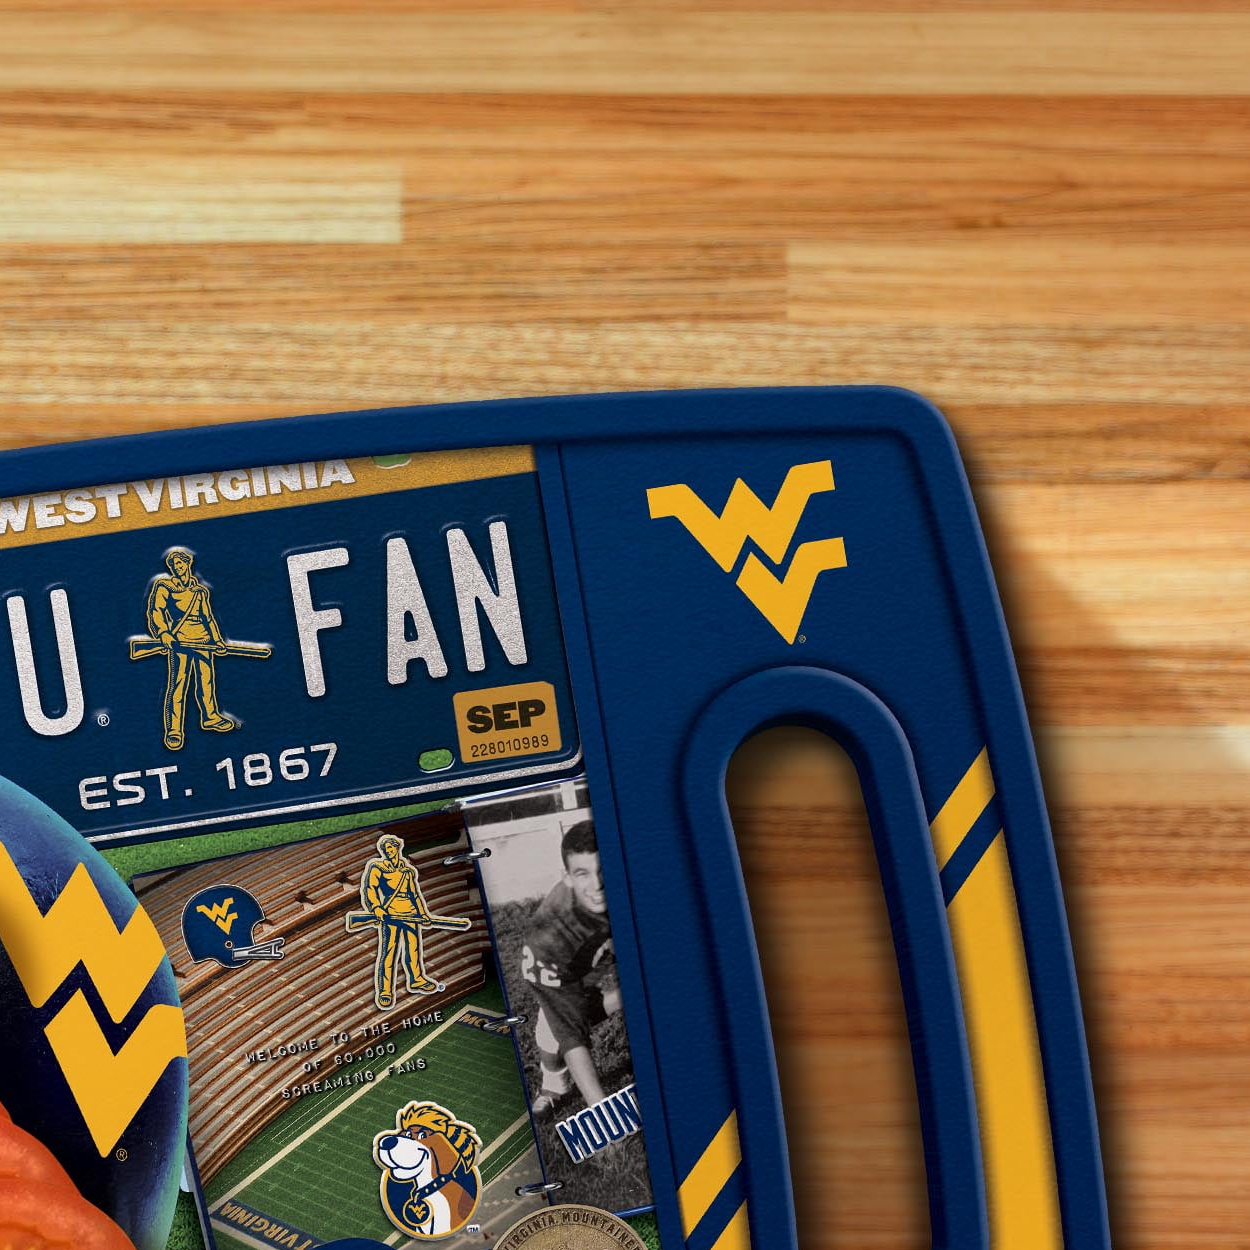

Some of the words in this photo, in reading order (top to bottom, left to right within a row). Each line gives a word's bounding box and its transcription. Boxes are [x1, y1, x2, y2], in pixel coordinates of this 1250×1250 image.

[132, 459, 356, 513] VIRGINIA
[287, 521, 527, 698] FAN
[467, 699, 546, 734] SEP
[471, 734, 549, 758] 228010989
[78, 765, 193, 811] EST.
[216, 742, 338, 790] 1867
[246, 1039, 319, 1063] WELCOME
[330, 1032, 349, 1045] TO
[361, 1022, 391, 1037] THE
[402, 1011, 443, 1029] HOME
[282, 1070, 374, 1099] SCREAMING
[387, 1058, 426, 1076] FANS
[303, 1060, 323, 1073] OF
[220, 1202, 299, 1248] VIRGINIA
